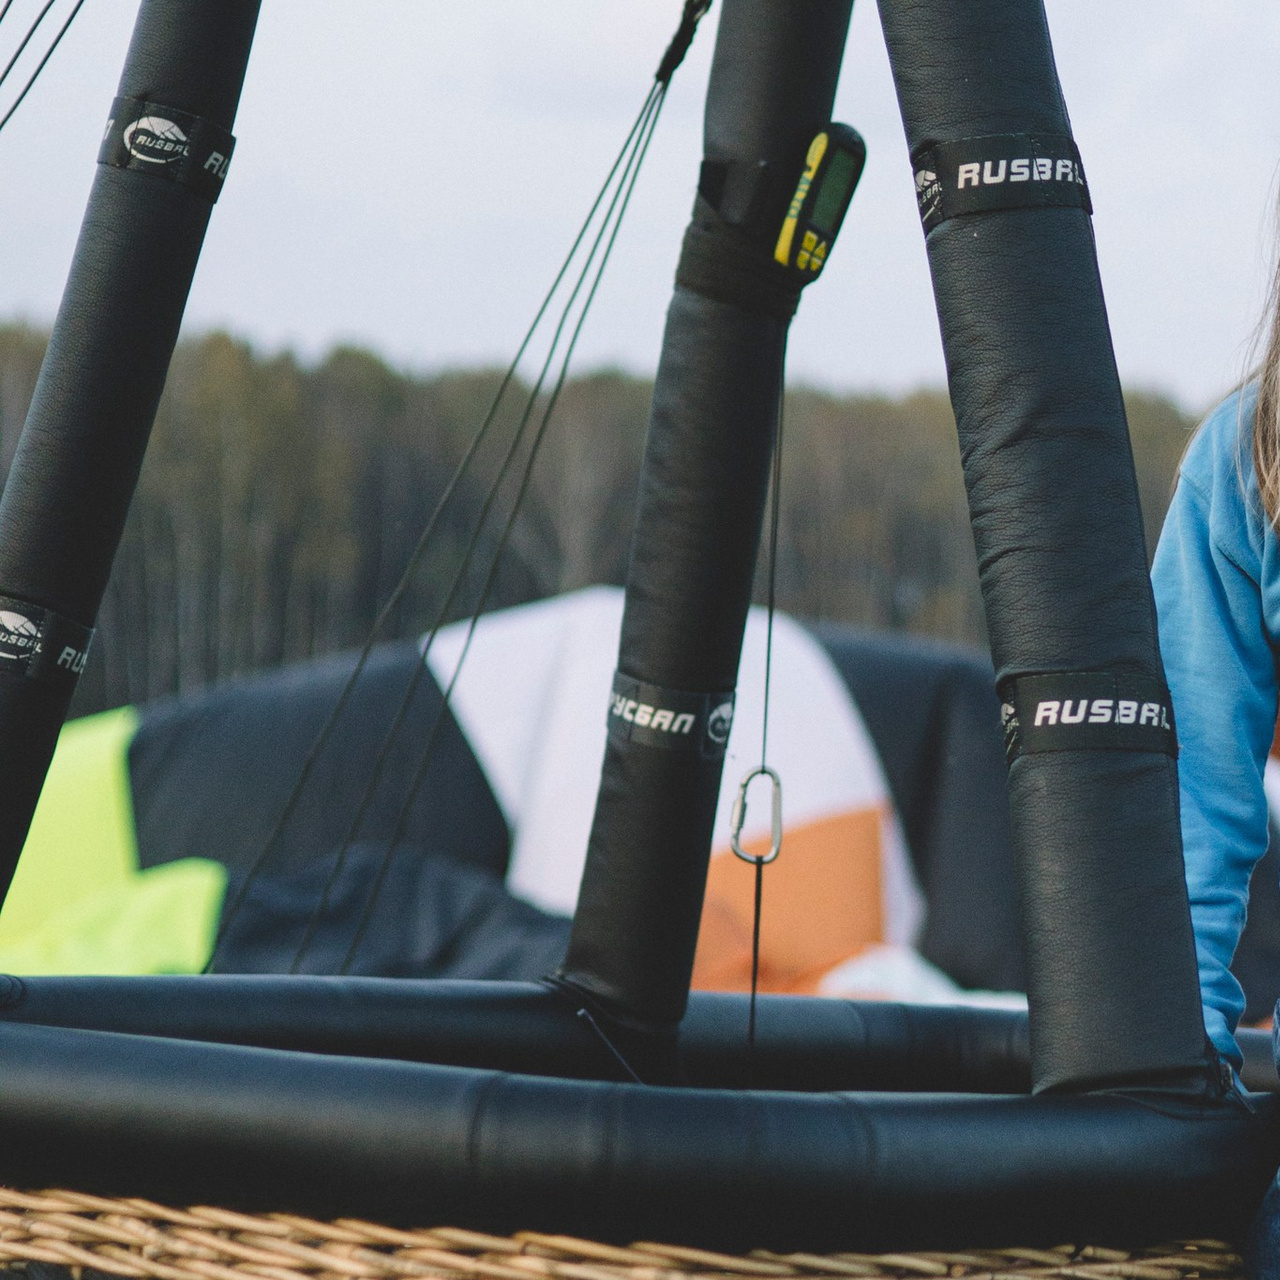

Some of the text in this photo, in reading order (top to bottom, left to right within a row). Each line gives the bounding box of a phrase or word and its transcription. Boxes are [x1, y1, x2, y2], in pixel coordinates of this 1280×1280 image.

[136, 134, 190, 157] RUSBAL
[957, 158, 1084, 190] RUSBAL
[0, 631, 42, 653] USBAL
[1034, 699, 1171, 730] RUSBAL
